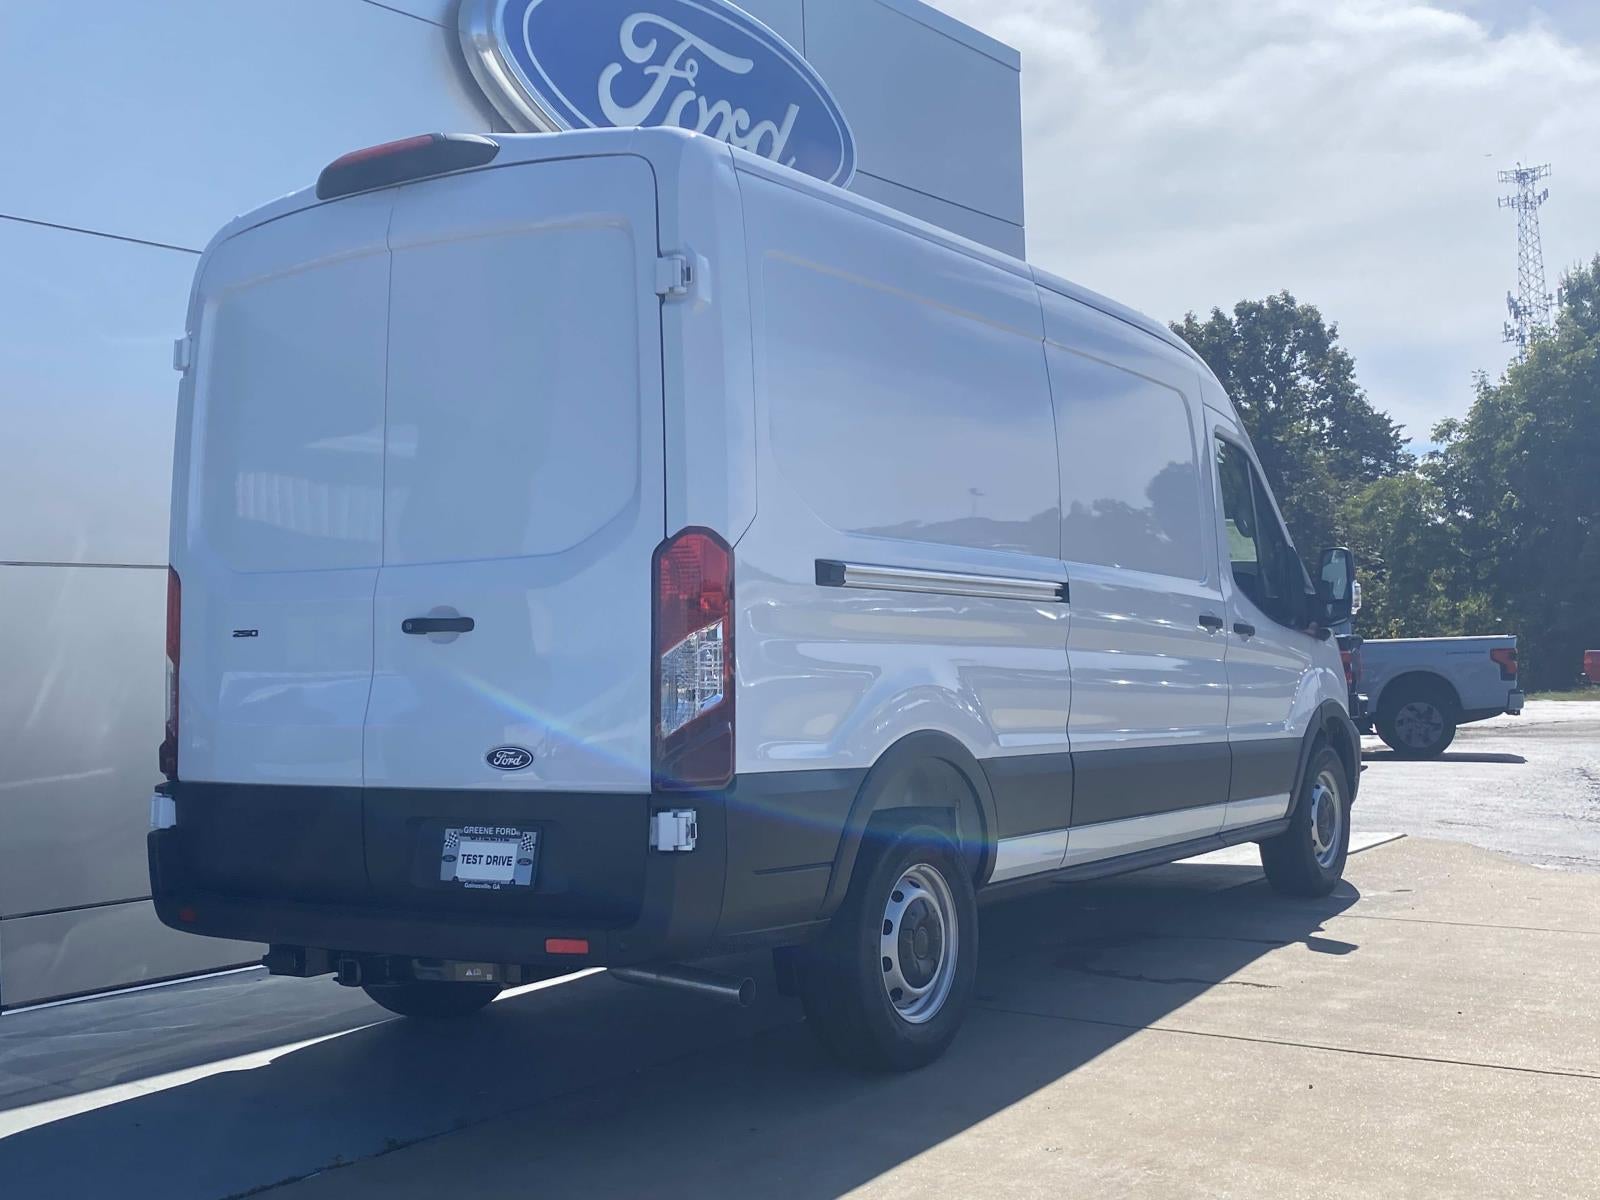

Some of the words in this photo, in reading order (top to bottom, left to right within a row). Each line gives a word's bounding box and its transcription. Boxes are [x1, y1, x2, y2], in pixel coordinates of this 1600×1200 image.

[598, 12, 801, 168] Ford
[232, 629, 259, 638] 250
[493, 750, 523, 766] Ford
[463, 826, 494, 835] GREENE
[495, 827, 517, 836] FORD
[461, 854, 484, 865] TEST
[485, 855, 513, 867] DRIVE
